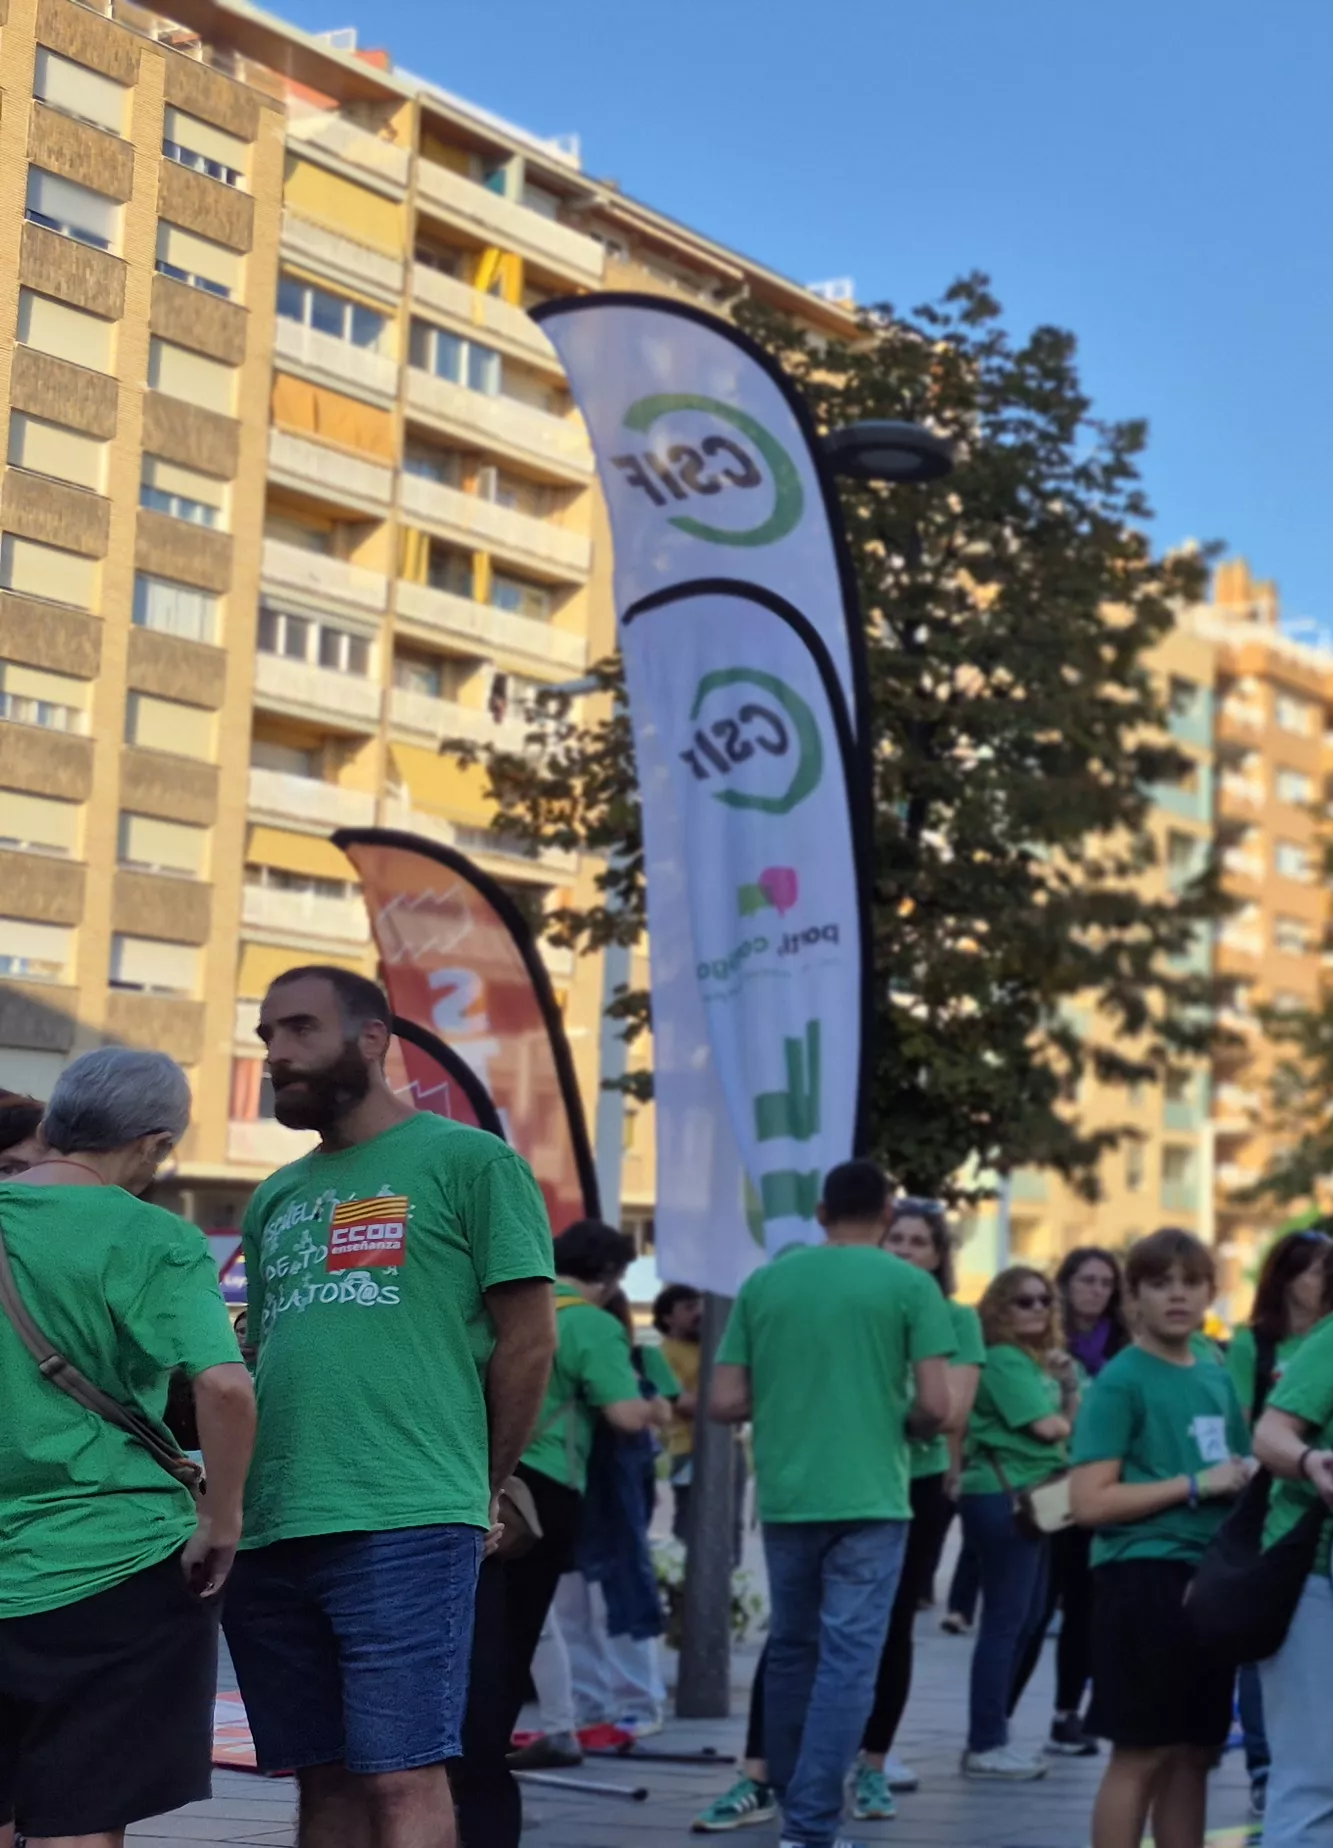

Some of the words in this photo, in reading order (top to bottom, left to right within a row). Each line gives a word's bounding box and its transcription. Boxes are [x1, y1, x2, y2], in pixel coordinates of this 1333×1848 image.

[331, 1222, 404, 1245] CCOO
[331, 1240, 402, 1255] enseñanza
[308, 1281, 401, 1306] TOD@S
